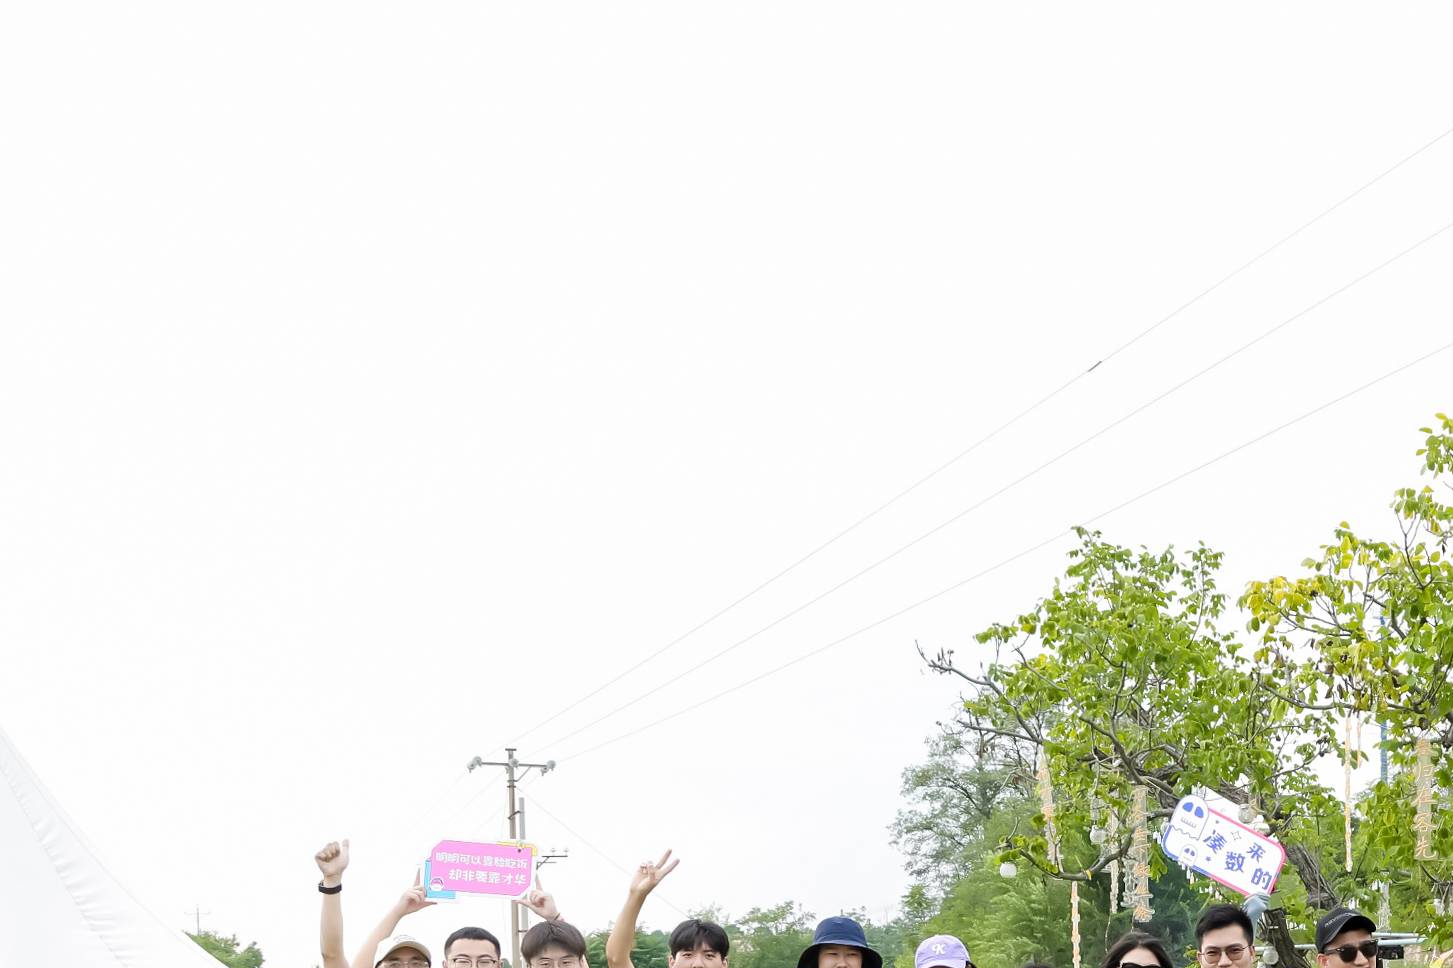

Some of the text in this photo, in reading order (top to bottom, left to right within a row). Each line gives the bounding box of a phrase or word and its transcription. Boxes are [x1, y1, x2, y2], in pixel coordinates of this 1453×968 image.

[448, 868, 527, 886] 却非要靠才华
